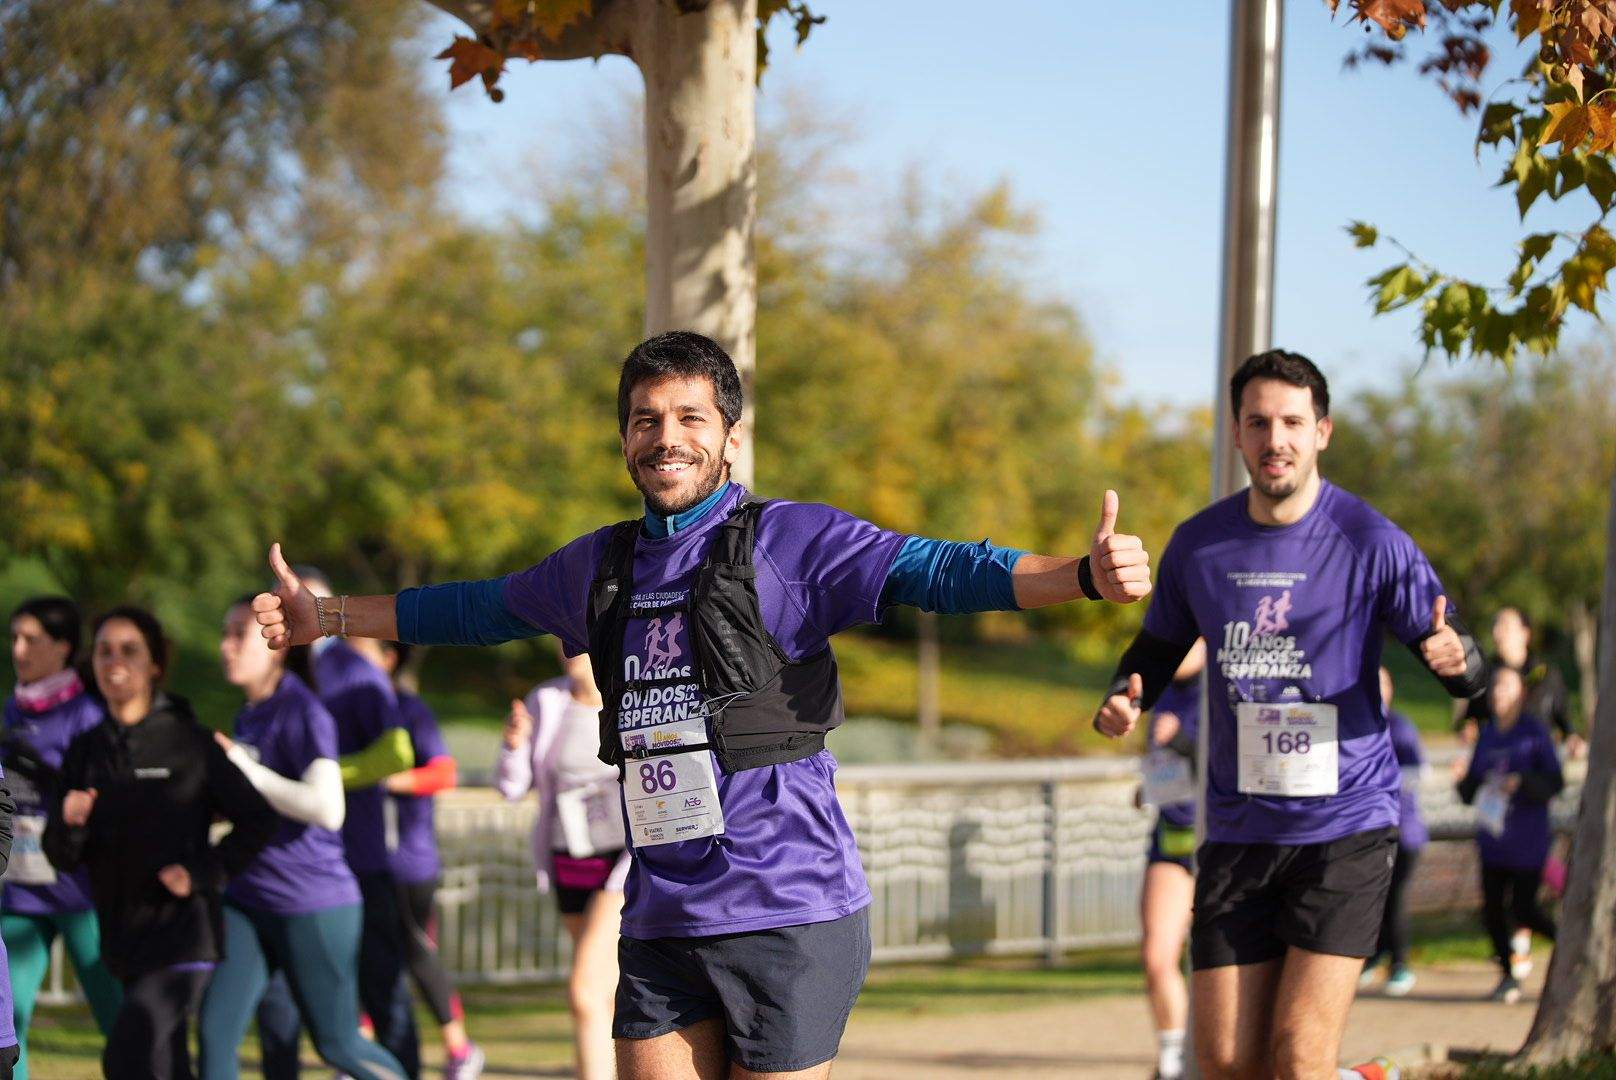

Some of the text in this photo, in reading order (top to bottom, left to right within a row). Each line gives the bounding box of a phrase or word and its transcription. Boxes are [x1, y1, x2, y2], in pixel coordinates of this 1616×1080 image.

[1223, 621, 1296, 650] 10 AÑOS
[624, 655, 640, 681] 0
[1217, 648, 1291, 664] MOVIDOS
[1221, 663, 1312, 679] ESPERANZA
[619, 684, 687, 711] OVIDOS
[684, 693, 695, 701] LA
[617, 700, 710, 729] ESPERANZA
[1262, 731, 1310, 754] 168
[639, 759, 677, 794] 86
